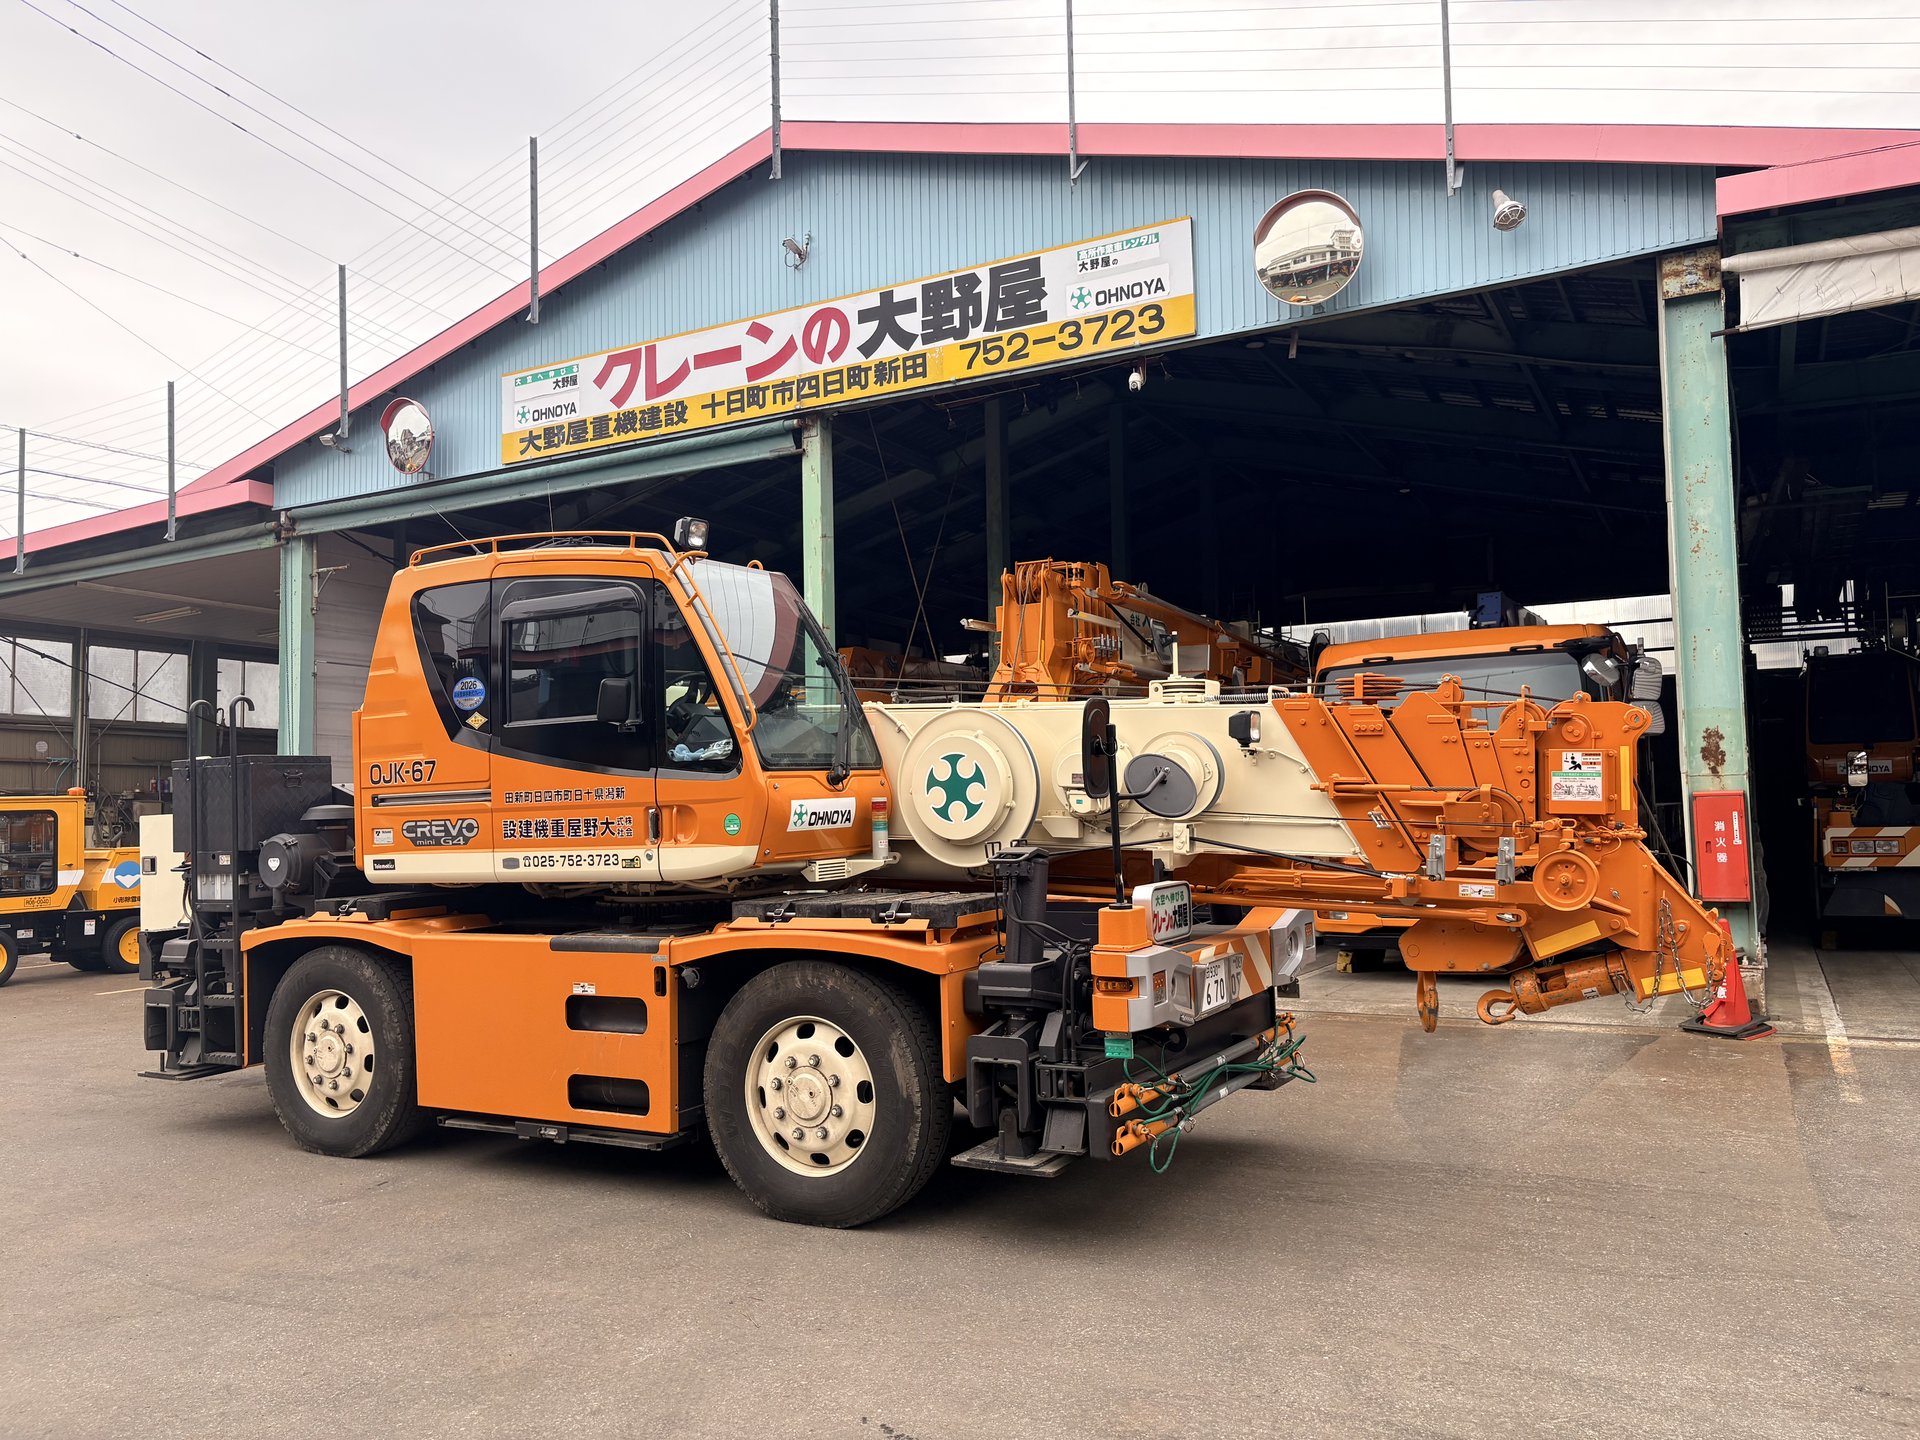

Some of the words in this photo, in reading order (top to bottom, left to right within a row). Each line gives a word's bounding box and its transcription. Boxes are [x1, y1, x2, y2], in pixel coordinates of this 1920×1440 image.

[1078, 256, 1118, 273] 大野屋の
[1095, 277, 1165, 306] OHNOYA
[519, 400, 688, 455] 大野屋重機建設
[701, 353, 928, 418] 十日町市四日町新田
[959, 304, 1165, 370] 752-3723
[552, 374, 578, 390] 大野屋
[532, 402, 577, 421] OHNOYA
[460, 680, 477, 690] 2026
[370, 760, 436, 785] OJK-67
[808, 809, 852, 826] OHNOYA
[402, 818, 479, 838] CREVO
[416, 838, 436, 846] mini
[440, 836, 465, 846] G4
[1714, 820, 1728, 863] 消火器
[532, 854, 619, 868] 025-752-3723
